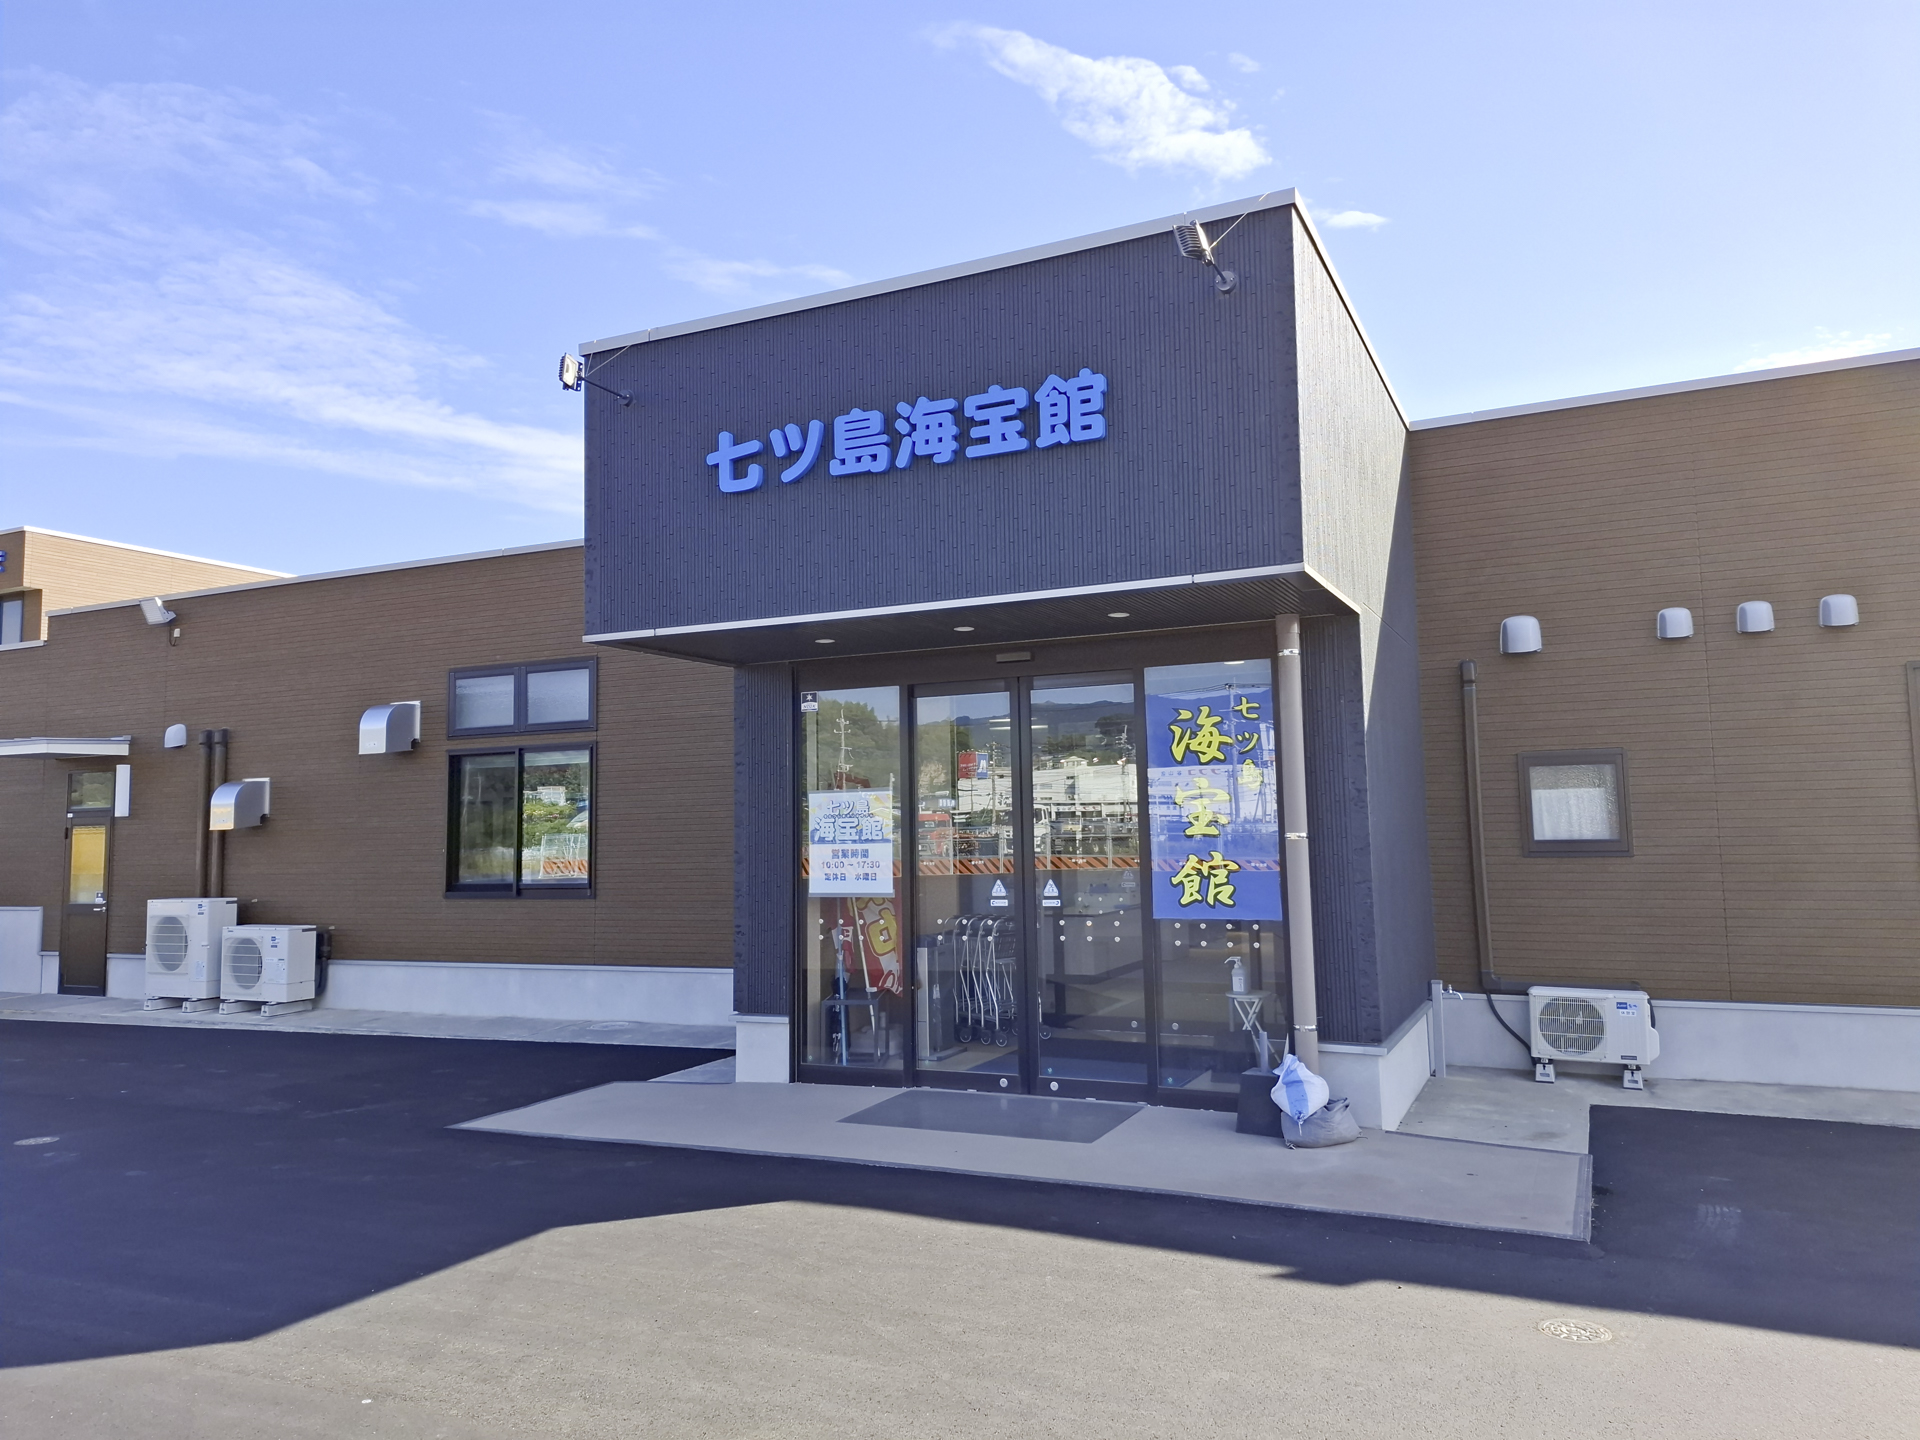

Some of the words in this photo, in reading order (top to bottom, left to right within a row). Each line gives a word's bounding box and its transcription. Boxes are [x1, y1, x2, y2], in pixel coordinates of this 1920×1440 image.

[706, 368, 1107, 493] 七ツ島海宝館
[1233, 696, 1265, 790] 七ツ島
[827, 800, 871, 815] 七ツ島
[1168, 705, 1241, 908] 海宝館
[814, 816, 884, 842] 海宝館
[831, 848, 870, 860] 営業時間
[824, 872, 847, 882] 定休日
[854, 872, 877, 882] 水曜日
